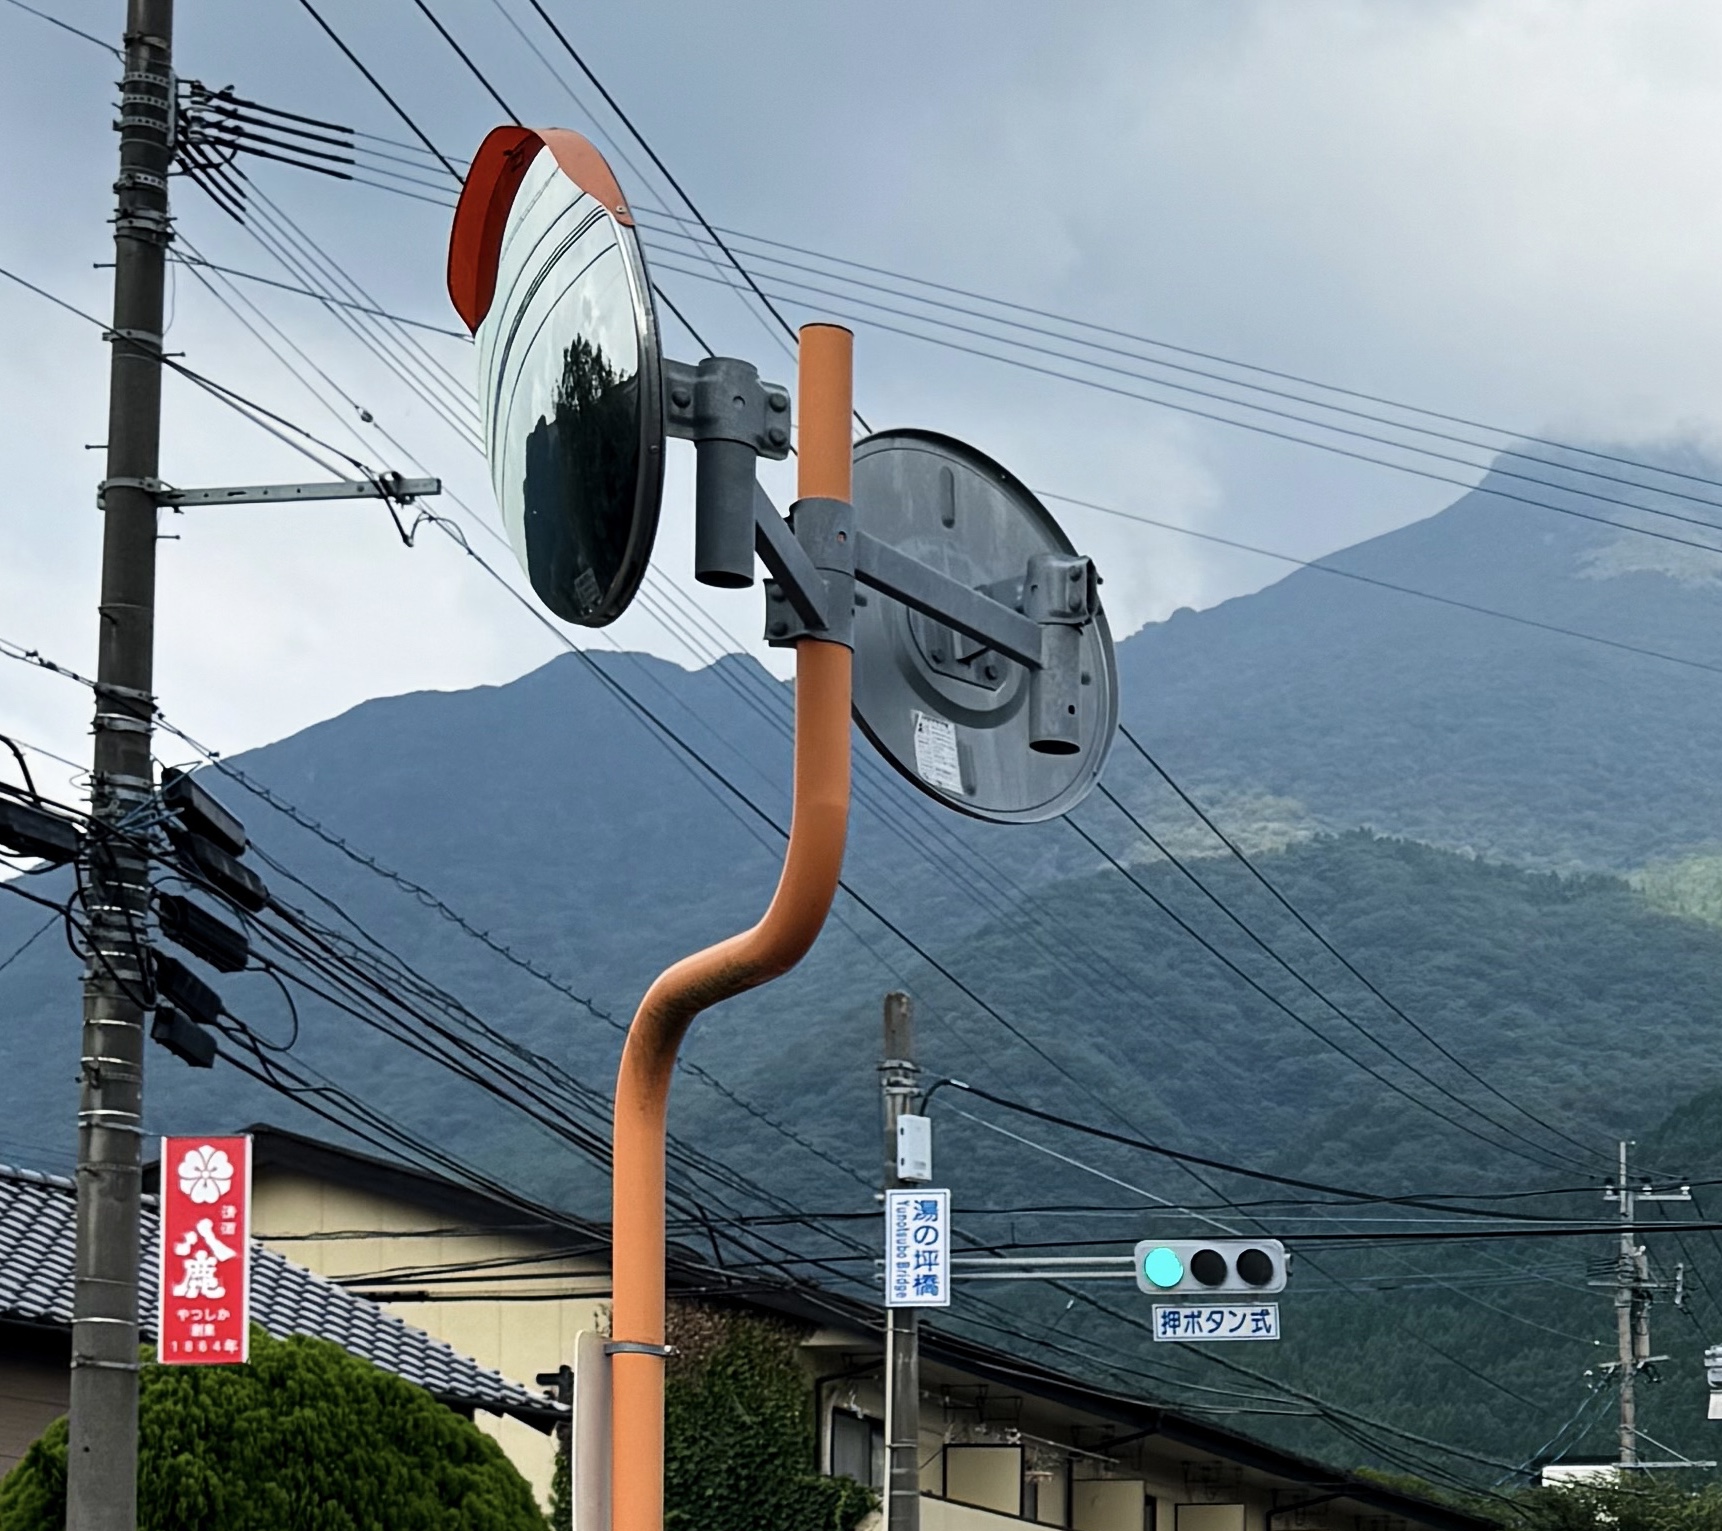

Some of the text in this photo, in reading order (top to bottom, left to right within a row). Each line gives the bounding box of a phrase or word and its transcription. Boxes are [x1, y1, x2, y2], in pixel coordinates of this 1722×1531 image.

[173, 1218, 237, 1299] 八鹿
[894, 1200, 911, 1299] Yunotsubo Bridge
[913, 1200, 940, 1296] 湯の坪橋
[176, 1308, 231, 1322] やつしか
[1161, 1309, 1272, 1335] 押ボタン式
